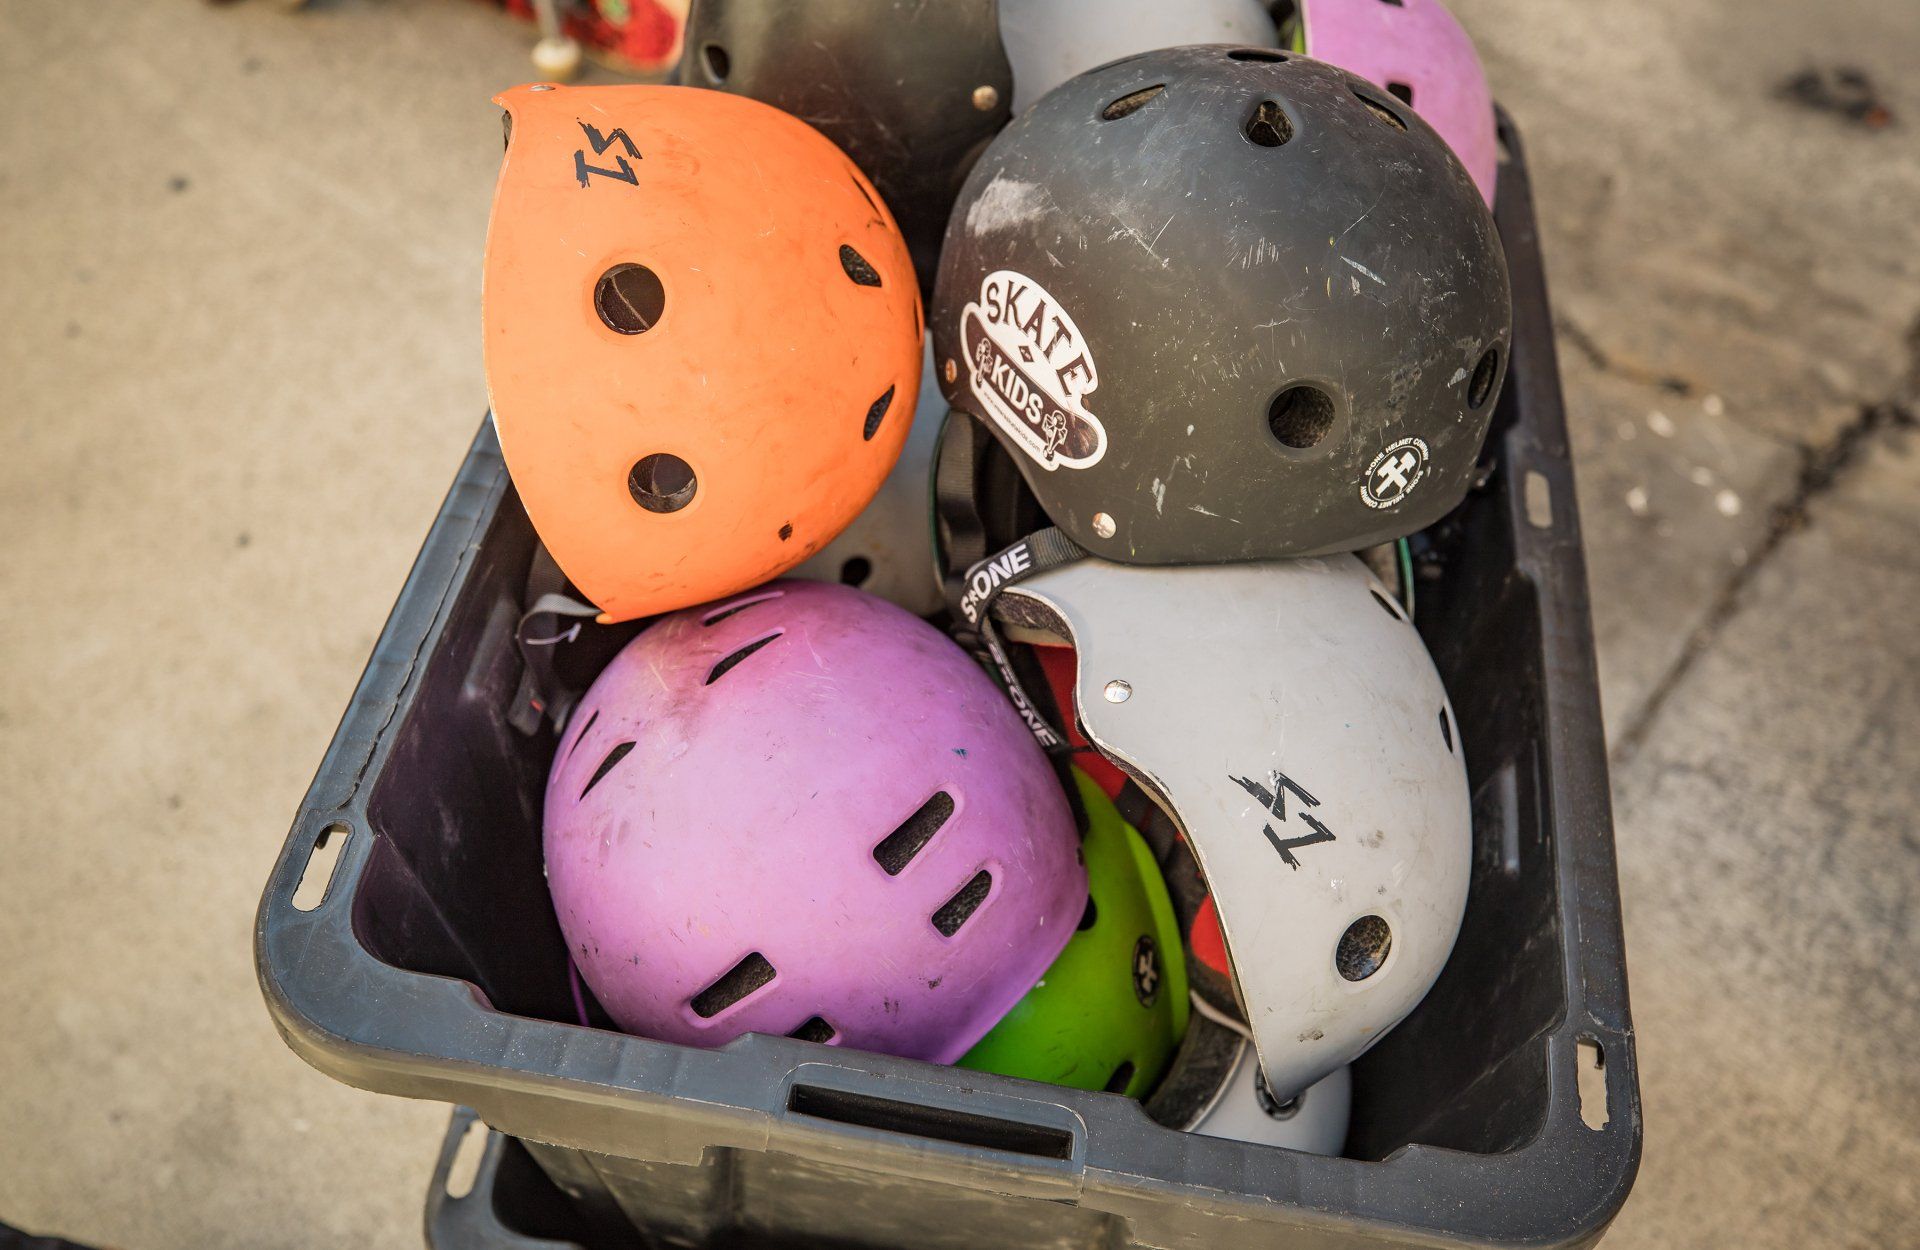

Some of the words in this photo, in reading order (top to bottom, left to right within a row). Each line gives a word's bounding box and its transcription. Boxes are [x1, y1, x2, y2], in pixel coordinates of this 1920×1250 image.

[986, 279, 1093, 398] SKATE
[990, 355, 1044, 424] KIDS
[1385, 437, 1413, 454] HELMET
